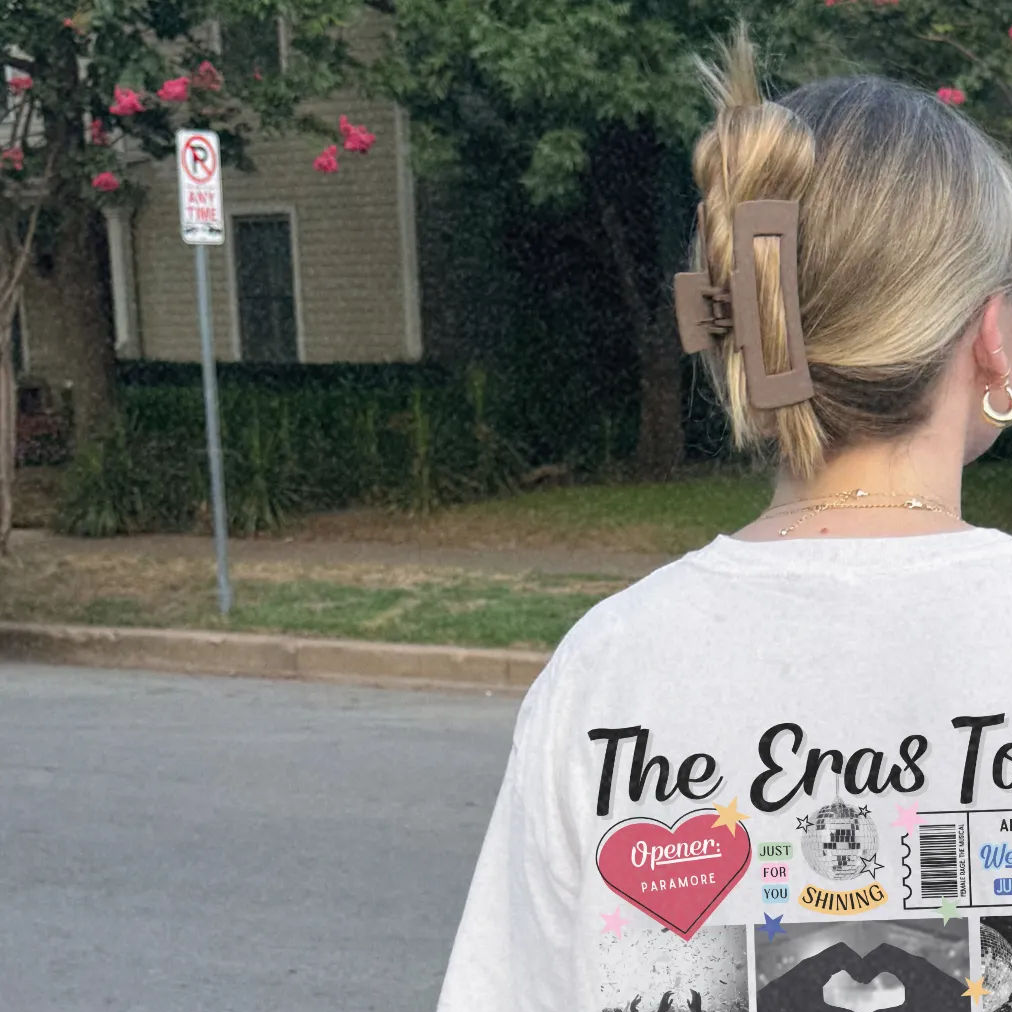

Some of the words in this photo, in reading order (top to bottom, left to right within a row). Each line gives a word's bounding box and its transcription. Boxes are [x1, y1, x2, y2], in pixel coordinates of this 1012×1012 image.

[188, 191, 215, 204] ANY
[186, 206, 217, 221] TIME
[587, 725, 724, 816] The
[750, 722, 929, 813] Eras
[631, 838, 721, 870] Opener:
[760, 845, 791, 856] JUST
[763, 867, 787, 878] FOR
[641, 872, 717, 893] PARAMORE
[763, 888, 788, 900] YOU
[802, 884, 885, 911] SHINING
